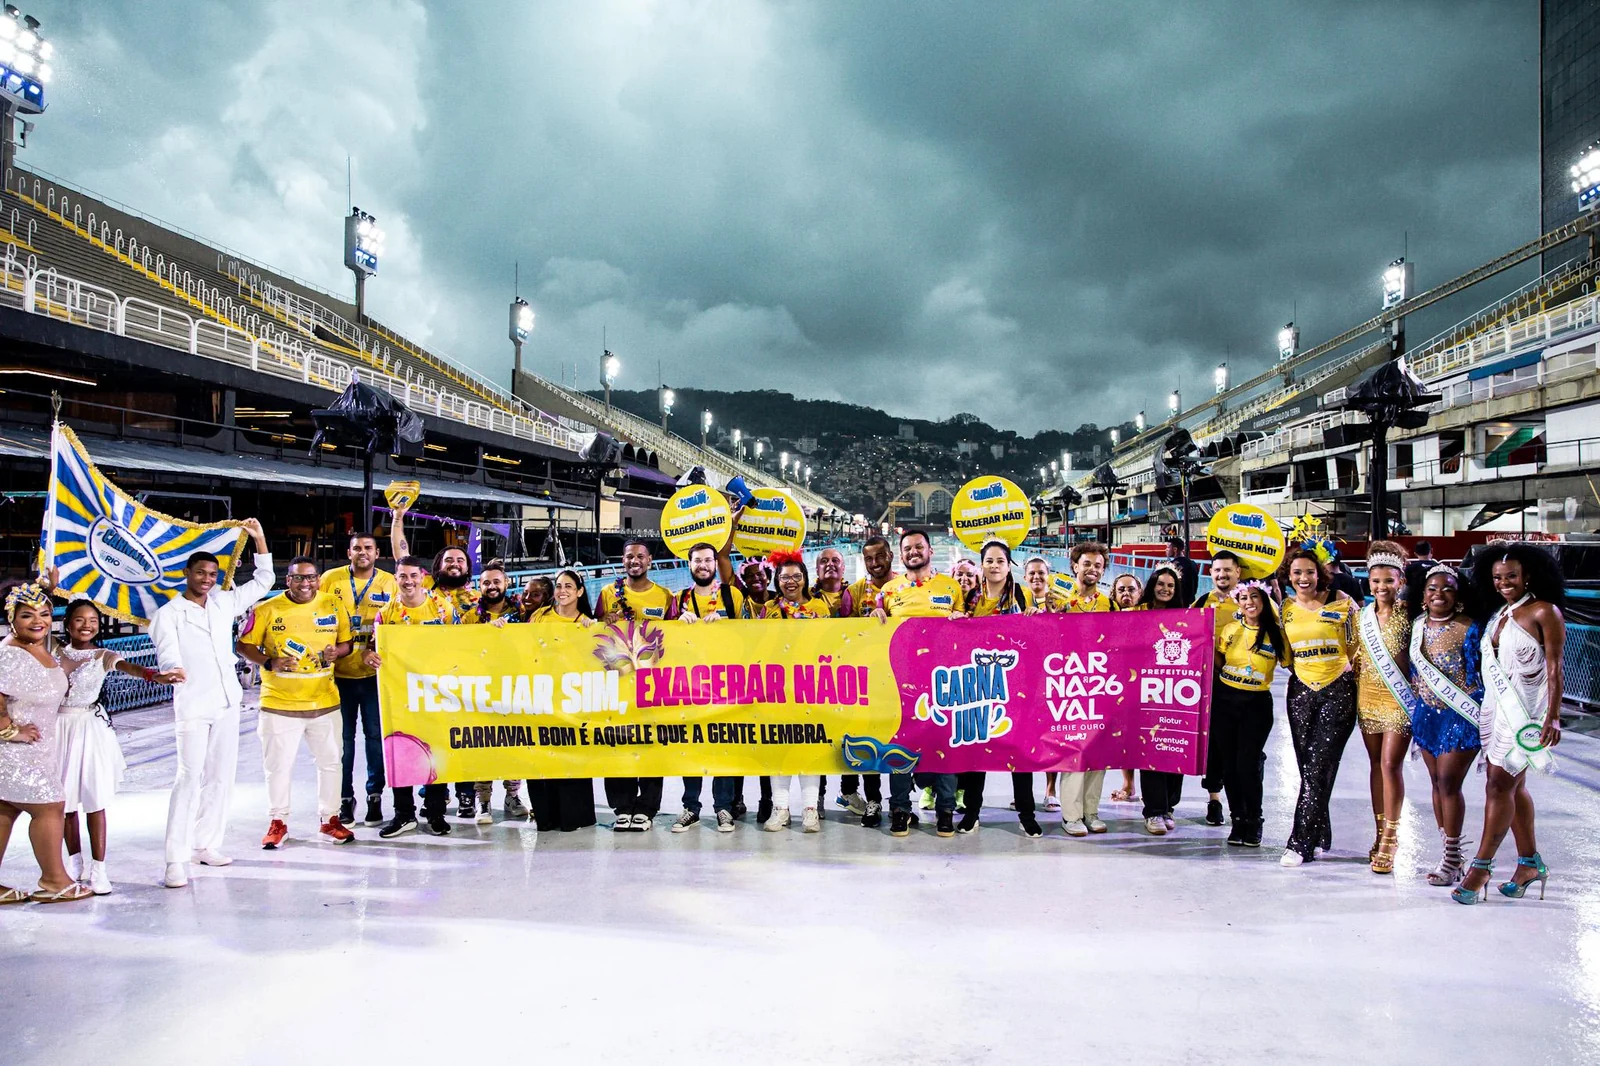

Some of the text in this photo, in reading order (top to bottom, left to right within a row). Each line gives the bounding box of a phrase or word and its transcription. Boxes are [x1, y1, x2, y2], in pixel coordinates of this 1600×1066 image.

[665, 520, 705, 537] EXAGERAR
[706, 516, 725, 527] NÃO!
[956, 510, 1024, 528] EXAGERAR NÃO!
[737, 524, 797, 538] XAGERAR NÃO!
[1210, 535, 1253, 551] EXAGERAR
[1255, 544, 1277, 556] NÃO!
[105, 556, 120, 566] RIO
[1043, 651, 1108, 675] CAR
[1141, 668, 1201, 676] PREFEITURA
[1364, 622, 1414, 708] RAINHA DA CASA
[406, 654, 869, 715] FESTEJAR SIM, EXAGERAR NÃO!
[935, 662, 1006, 707] CARNA
[1489, 664, 1508, 695] CASA
[1140, 677, 1201, 706] RIO
[1046, 698, 1103, 721] VAL
[1441, 686, 1457, 702] DA
[1460, 701, 1480, 722] CAS
[953, 705, 990, 744] JUV
[1160, 716, 1182, 725] Riotur
[450, 722, 833, 749] CARNAVAL BOM É AQUELE QUE A GENTE LEMBRA.
[1151, 736, 1189, 745] Juventude
[1156, 744, 1184, 753] Carioca
